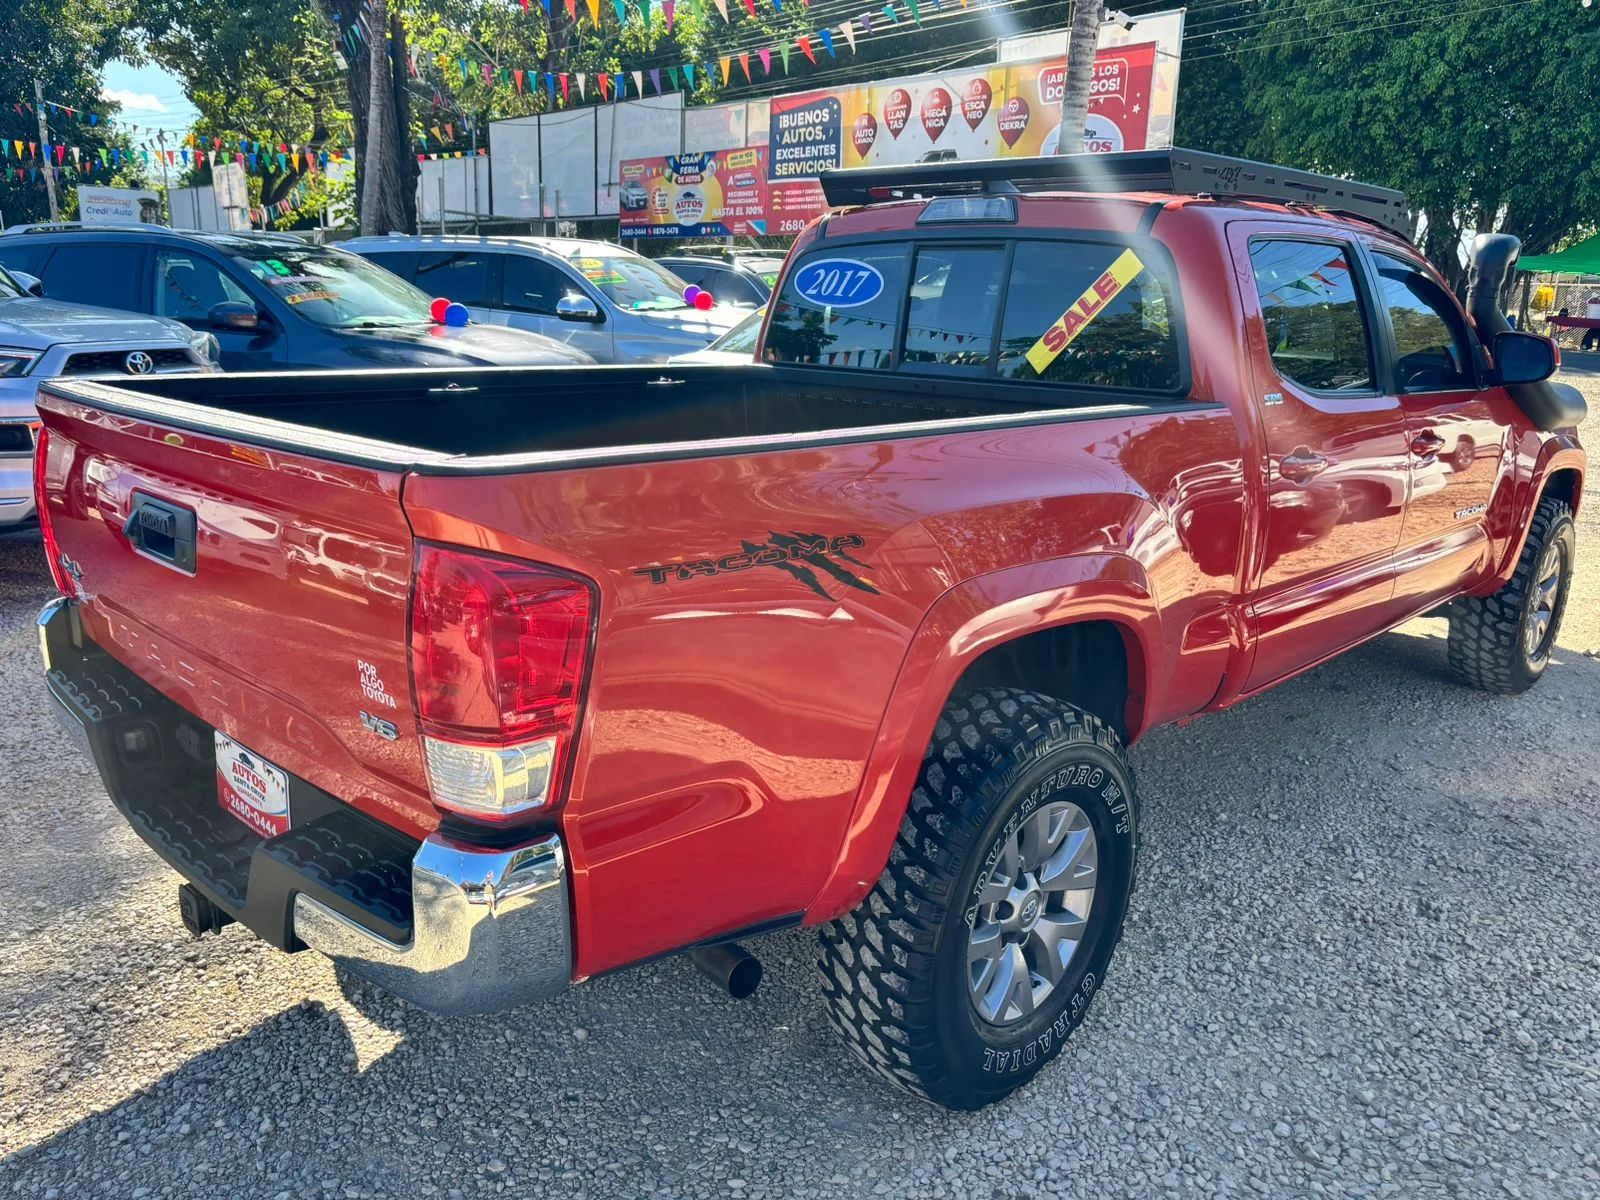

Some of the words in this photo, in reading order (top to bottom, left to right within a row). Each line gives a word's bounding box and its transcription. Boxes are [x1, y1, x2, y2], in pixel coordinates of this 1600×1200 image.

[1099, 64, 1120, 77] LOS
[1046, 77, 1121, 100] DOGOS!
[925, 105, 947, 119] MECÁ
[965, 101, 986, 111] ESCA
[779, 108, 830, 129] ¡BUENOS
[888, 109, 906, 120] LLAN
[967, 110, 983, 120] NEO
[889, 119, 904, 130] TAS
[926, 118, 945, 128] NICA
[782, 125, 826, 145] AUTOS,
[855, 128, 874, 138] AUTO
[775, 144, 837, 160] EXCELENTES
[680, 155, 700, 165] GRAN
[775, 158, 836, 176] SERVICIOS!
[680, 165, 700, 175] FERIA
[677, 175, 685, 183] DE
[685, 174, 702, 183] AUTOS
[727, 175, 734, 186] A
[754, 189, 759, 197] Y
[113, 207, 133, 217] Auto
[675, 200, 704, 210] AUTOS
[711, 206, 735, 217] HASTA
[735, 206, 744, 216] EL
[745, 205, 764, 216] 100%
[780, 219, 805, 232] 2680
[805, 268, 871, 298] 2017
[1042, 271, 1122, 353] SALE
[630, 532, 866, 585] TACOMA
[357, 659, 377, 679] POR
[360, 672, 385, 692] ALGO
[361, 683, 397, 710] TOYOTA
[359, 709, 399, 742] V6
[231, 760, 268, 794] AUTOS
[233, 775, 251, 790] SANTA
[230, 794, 278, 837] 2680-0444
[1070, 972, 1096, 1019] GT
[982, 1009, 1072, 1074] RADIAL
